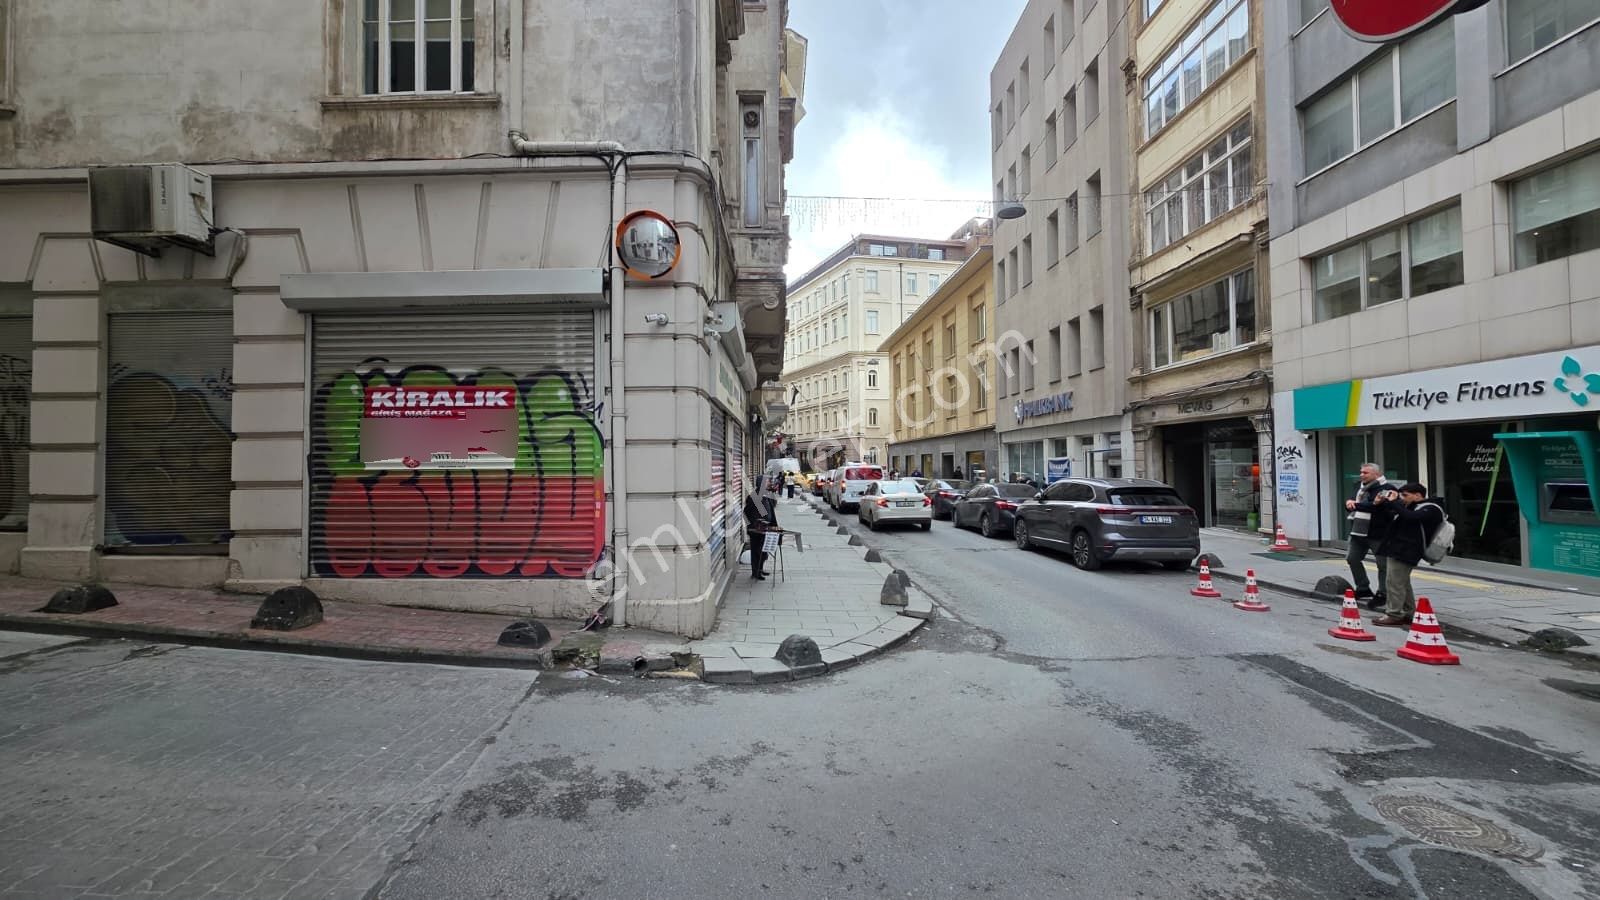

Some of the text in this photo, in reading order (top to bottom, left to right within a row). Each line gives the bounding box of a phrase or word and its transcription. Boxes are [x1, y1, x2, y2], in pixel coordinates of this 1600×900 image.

[371, 387, 510, 408] KİRALIK
[1373, 380, 1546, 410] Türkiye Finans
